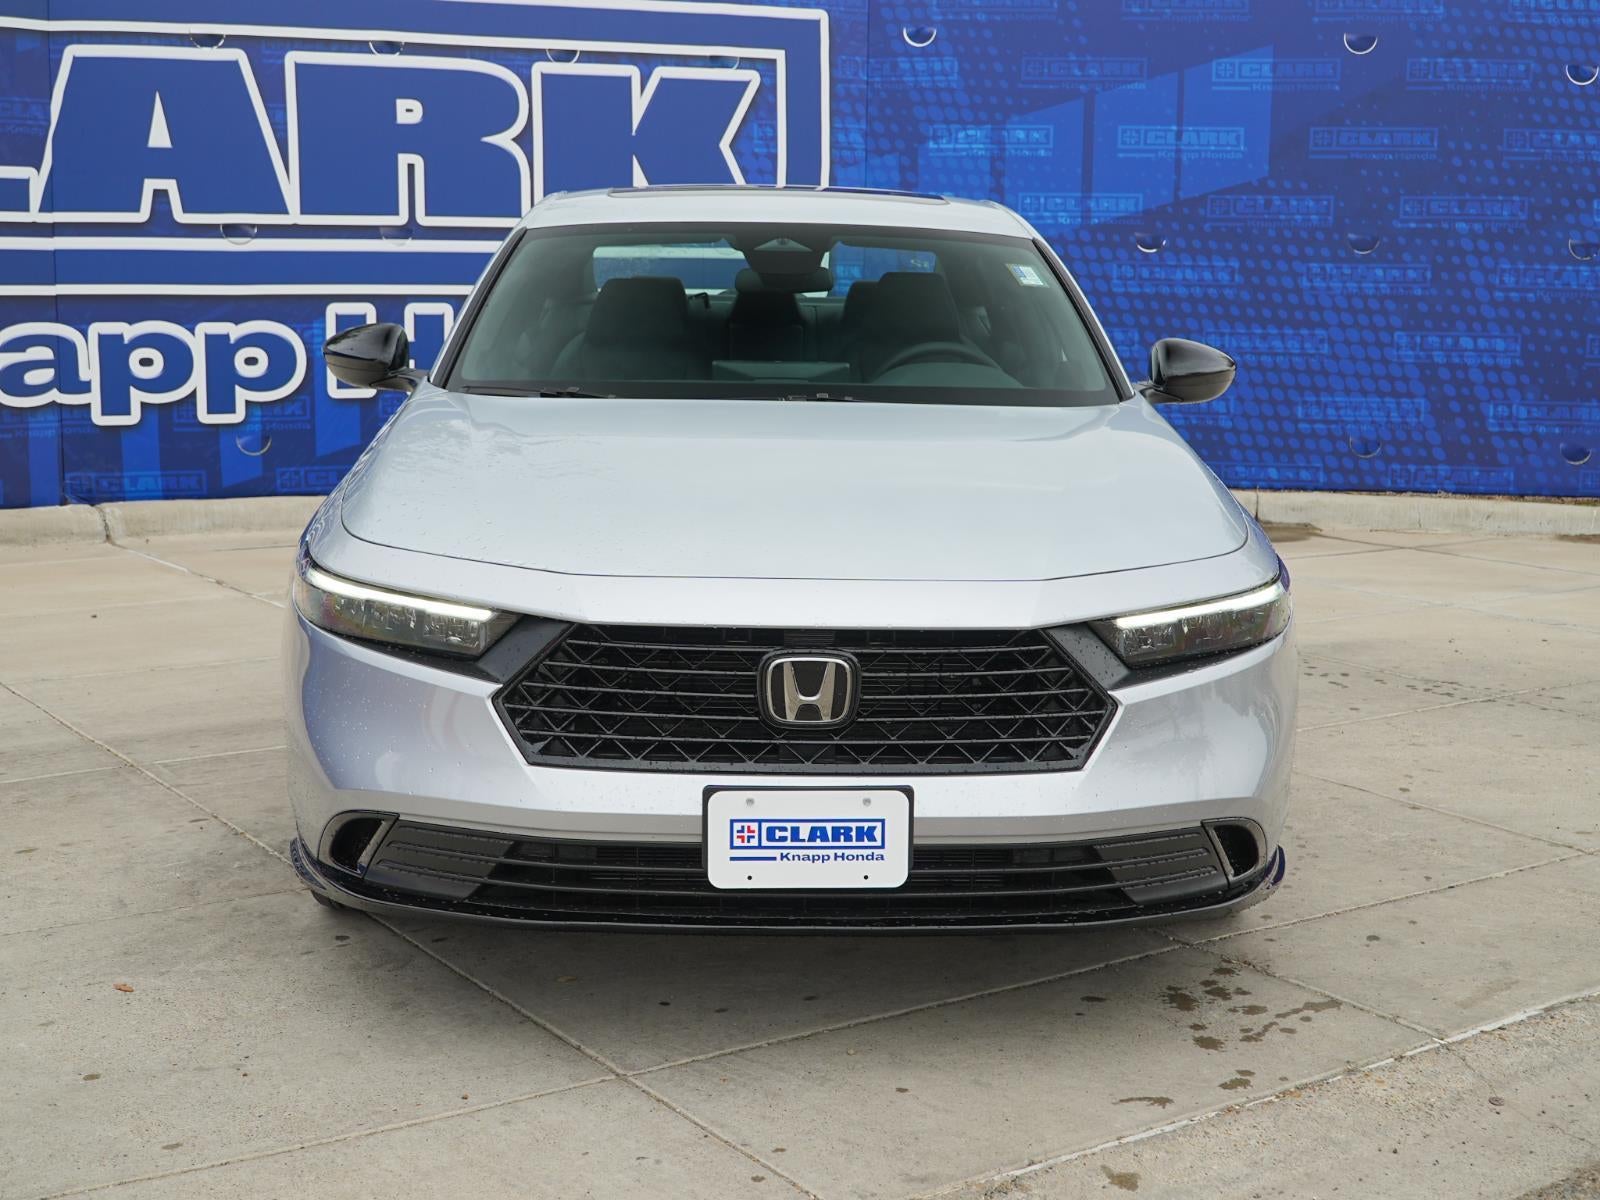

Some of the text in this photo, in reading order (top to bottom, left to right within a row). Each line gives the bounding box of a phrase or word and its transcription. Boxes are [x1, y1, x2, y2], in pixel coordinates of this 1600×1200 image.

[1241, 64, 1334, 76] CLARK
[1146, 131, 1239, 143] CLARK
[1339, 133, 1432, 145] CLARK
[766, 826, 878, 843] CLARK
[780, 852, 885, 864] Knapp Honda
